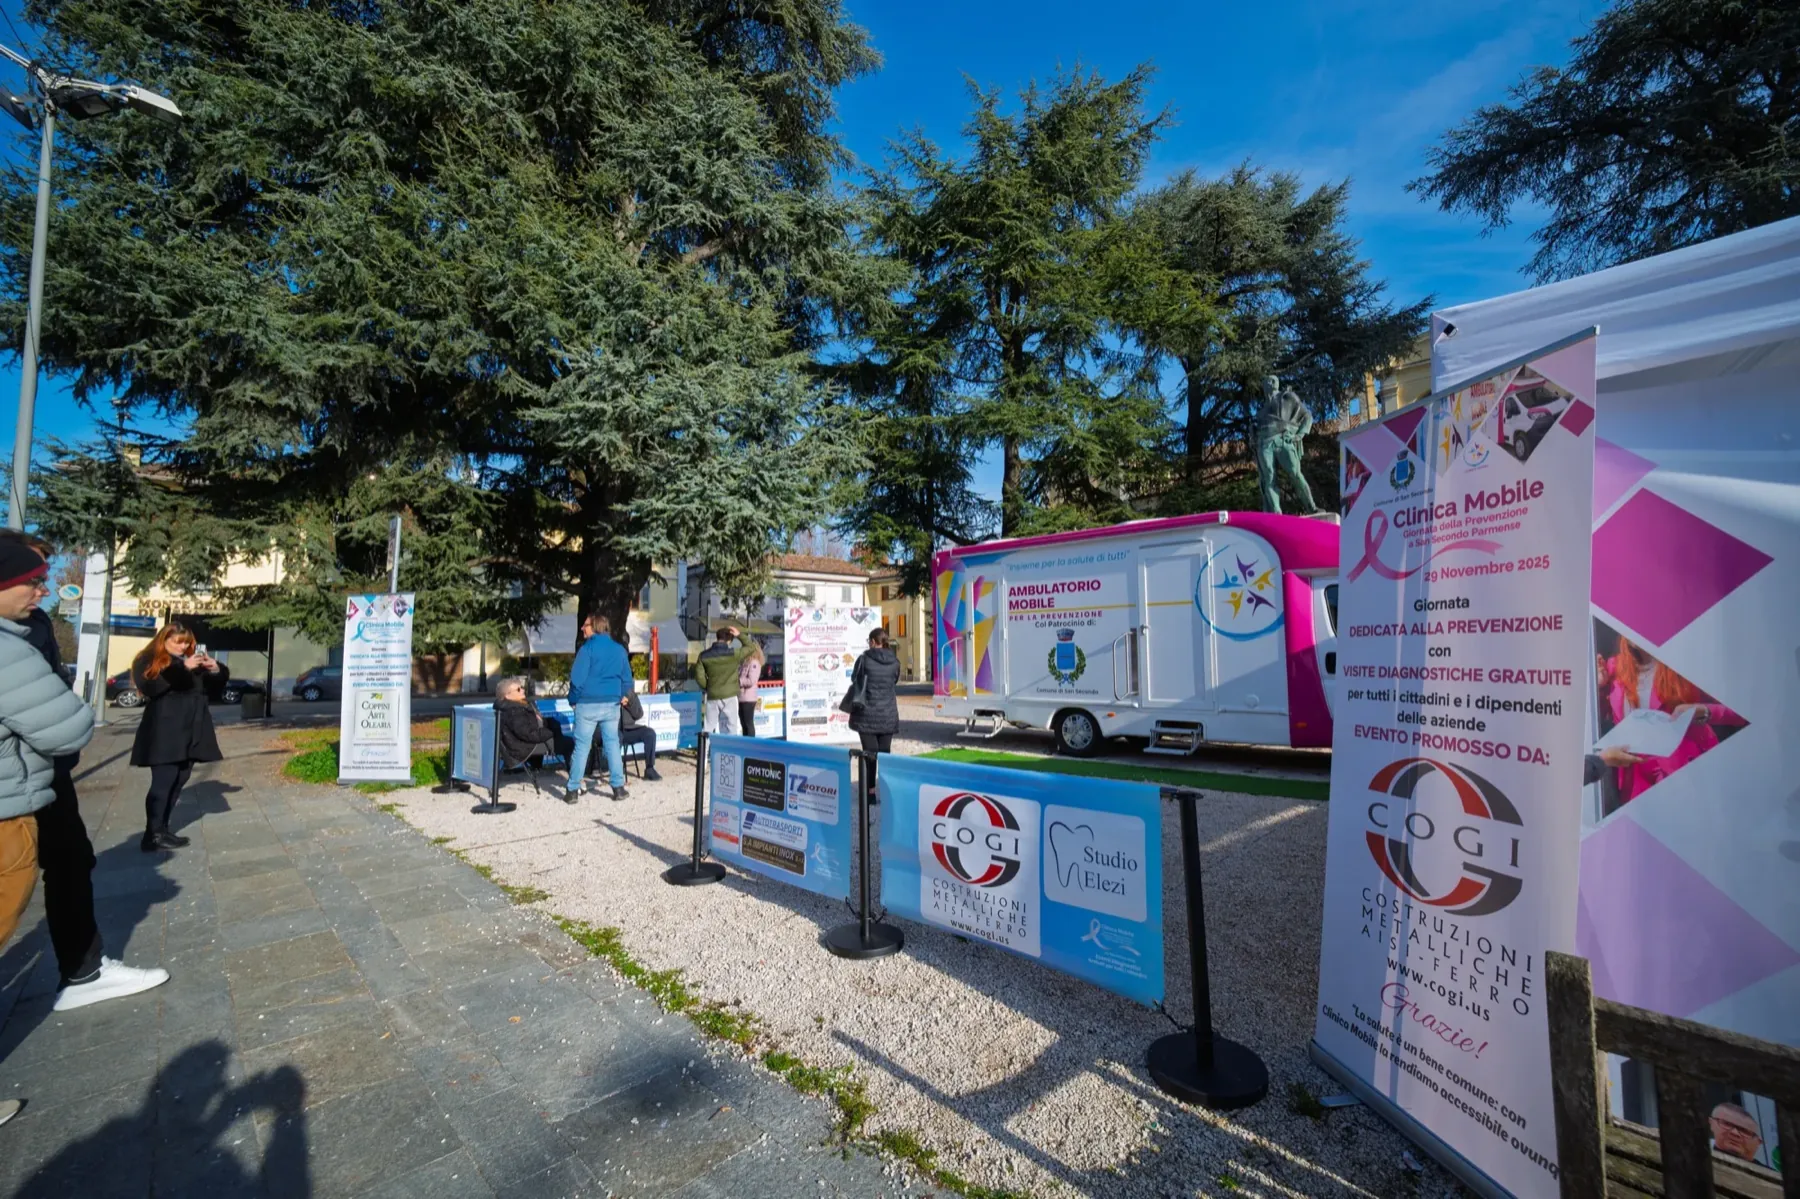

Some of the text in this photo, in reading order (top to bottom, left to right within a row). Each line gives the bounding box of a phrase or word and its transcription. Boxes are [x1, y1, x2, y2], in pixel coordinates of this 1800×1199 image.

[1373, 499, 1393, 507] Comune
[1411, 488, 1434, 499] Secondo
[1393, 479, 1544, 528] Clinica Mobile
[1403, 507, 1528, 539] Giornata della Prevenzione
[1416, 538, 1430, 547] San
[1432, 530, 1469, 543] Secondo
[1472, 522, 1521, 537] Parmense
[1041, 560, 1055, 569] per
[1057, 557, 1066, 566] la
[1067, 556, 1095, 566] salute
[1096, 552, 1105, 562] di
[1424, 555, 1549, 583] 29 Novembre 2025
[1009, 580, 1101, 596] AMBULATORIO
[138, 599, 190, 609] MONTE
[1009, 597, 1054, 610] MOBILE
[1041, 610, 1103, 619] PREVENZIONE
[1414, 597, 1469, 612] Giornata
[1048, 619, 1084, 628] Patrocinio
[1087, 619, 1096, 627] di:
[1349, 615, 1563, 637] DEDICATA ALLA PREVENZIONE
[1428, 646, 1451, 657] con
[1343, 666, 1571, 685] VISITE DIAGNOSTICHE GRATUITE
[1347, 689, 1562, 716] per tutti i cittadini e i dipendenti
[1397, 711, 1486, 732] delle aziende
[1354, 724, 1550, 766] EVENTO PROMOSSO DA:
[747, 766, 781, 779] GYM TONIC
[789, 774, 808, 794] TZ
[801, 784, 837, 795] MOTORI
[933, 823, 1019, 855] COGI
[1368, 802, 1519, 868] COGI
[753, 839, 779, 854] IMPIANTI
[779, 849, 795, 860] INOX
[1084, 846, 1137, 872] Studio
[933, 878, 1027, 912] COSTRUZIONI
[1085, 870, 1126, 895] Elezi
[933, 890, 1027, 926] METALLICHE
[933, 901, 1026, 938] AISI-FERRO
[950, 920, 1010, 945] www.cogi.us
[1362, 887, 1532, 972] COSTRUZIONI
[1362, 904, 1532, 996] METALLICHE
[1361, 923, 1530, 1017] AISI-FERRO
[1387, 956, 1490, 1023] www.cogi.us
[1381, 982, 1489, 1059] Grazie!
[1322, 1004, 1349, 1030] Clinica
[1350, 1023, 1378, 1050] Mobile
[1379, 1043, 1388, 1058] la
[1390, 1053, 1439, 1093] rendiamo
[1440, 1088, 1509, 1142] accessibile
[1367, 1016, 1395, 1041] salute
[1396, 1033, 1402, 1046] è
[1403, 1041, 1417, 1055] un
[1419, 1048, 1444, 1074] bene
[1446, 1069, 1499, 1111] comune:
[1501, 1105, 1526, 1129] con
